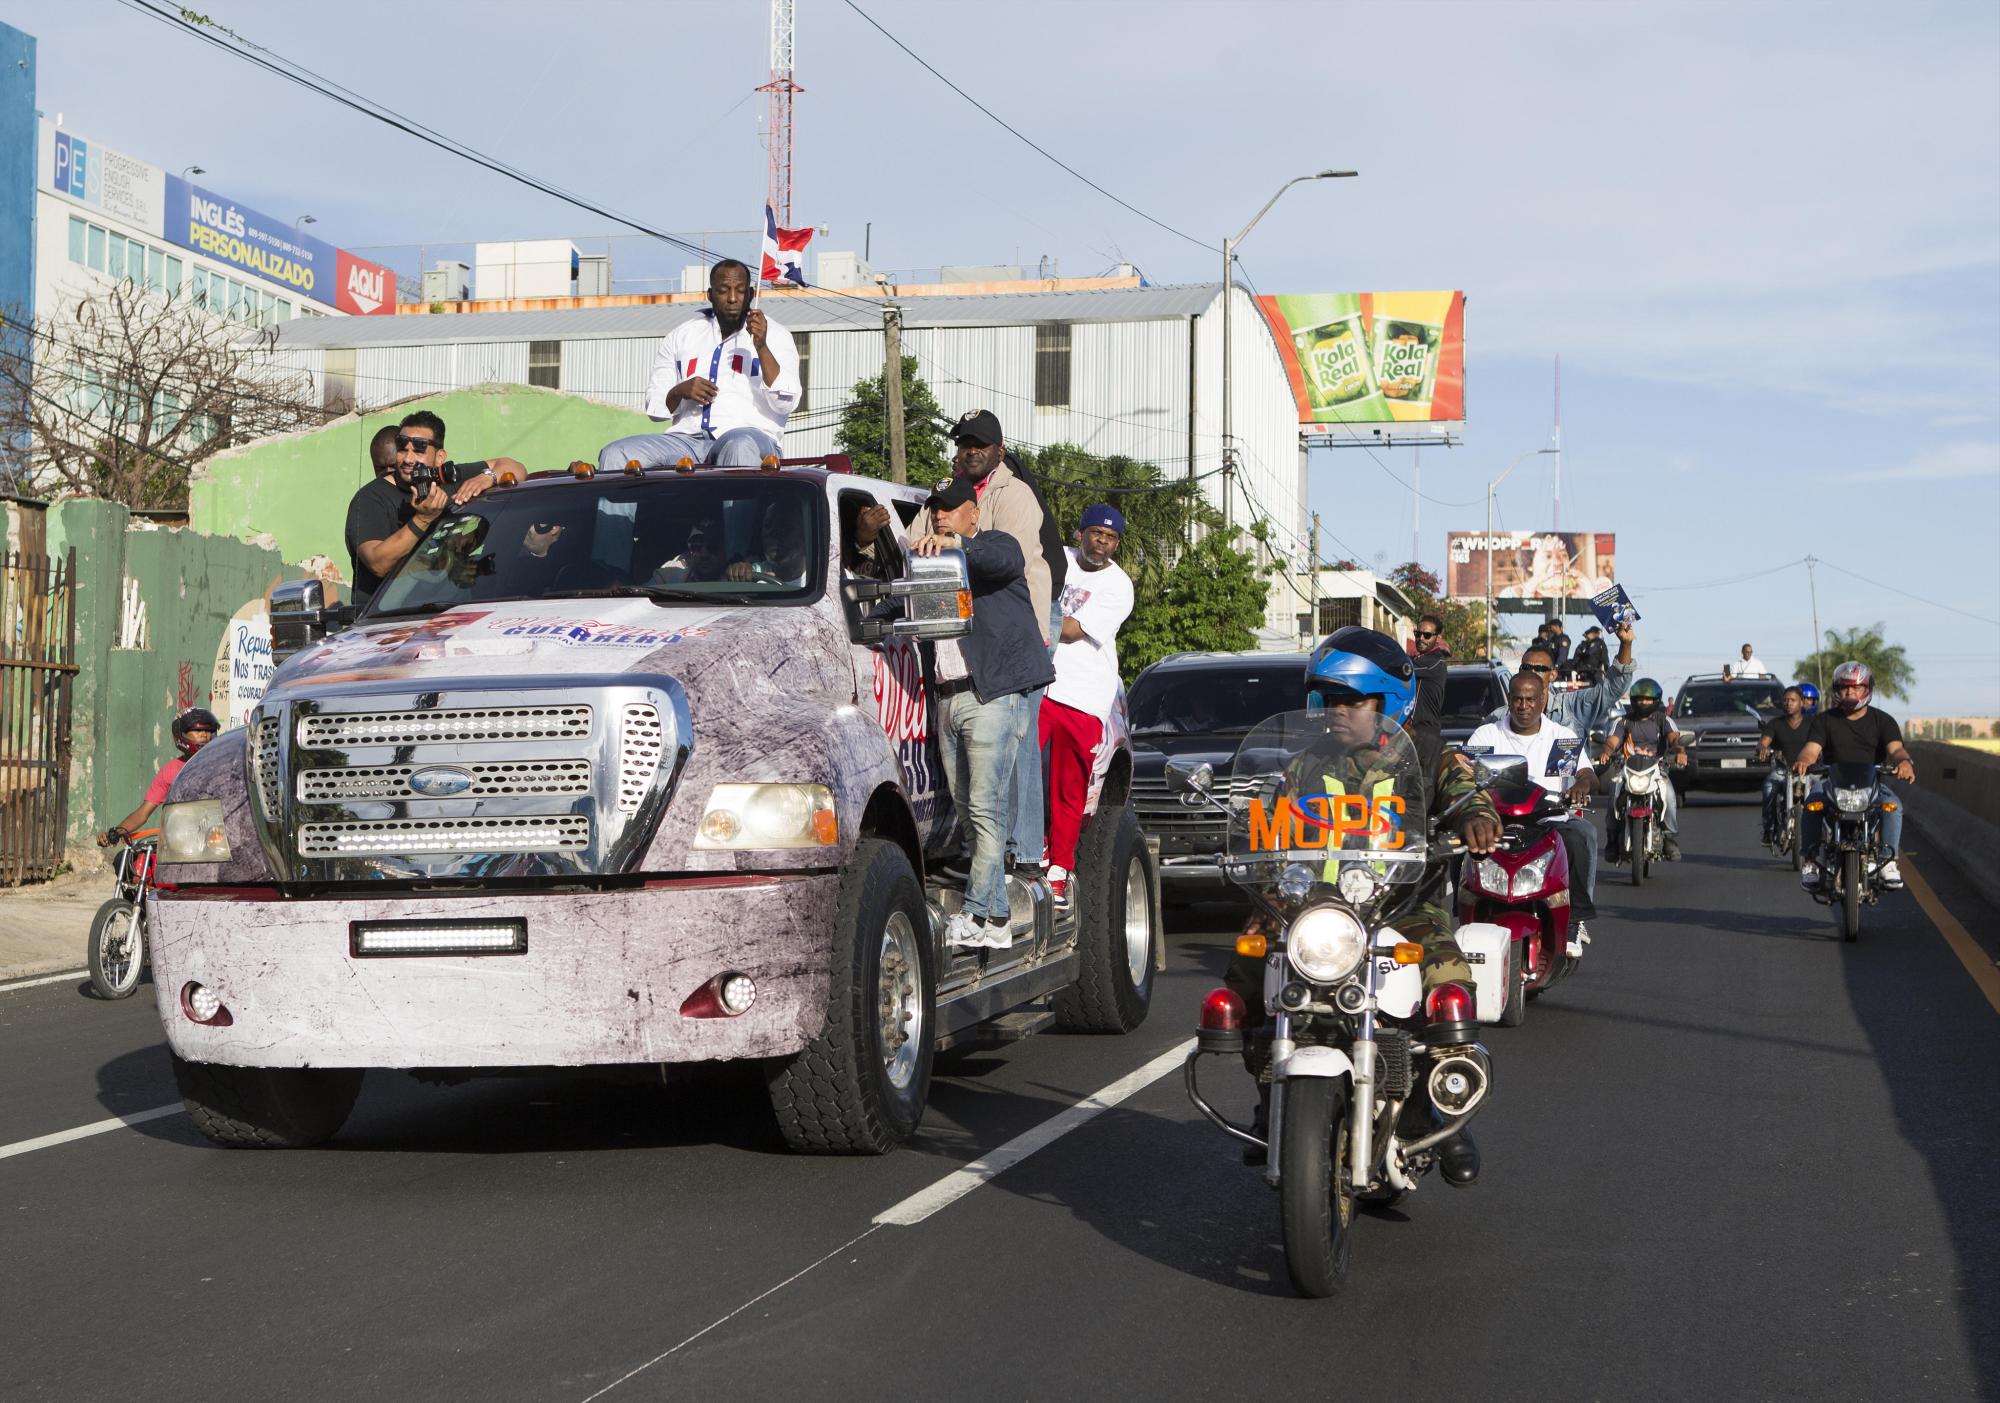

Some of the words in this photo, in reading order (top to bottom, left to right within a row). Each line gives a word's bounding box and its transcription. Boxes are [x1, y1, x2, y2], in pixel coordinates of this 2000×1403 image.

[191, 195, 245, 238] INGLÉS
[190, 221, 314, 290] PERSONALIZADO
[348, 264, 384, 303] AQUÍ
[1314, 341, 1356, 371] Kola
[1381, 361, 1422, 381] Real
[1384, 344, 1425, 364] Kola
[1318, 356, 1360, 388] Real
[1250, 793, 1406, 850] MOPC
